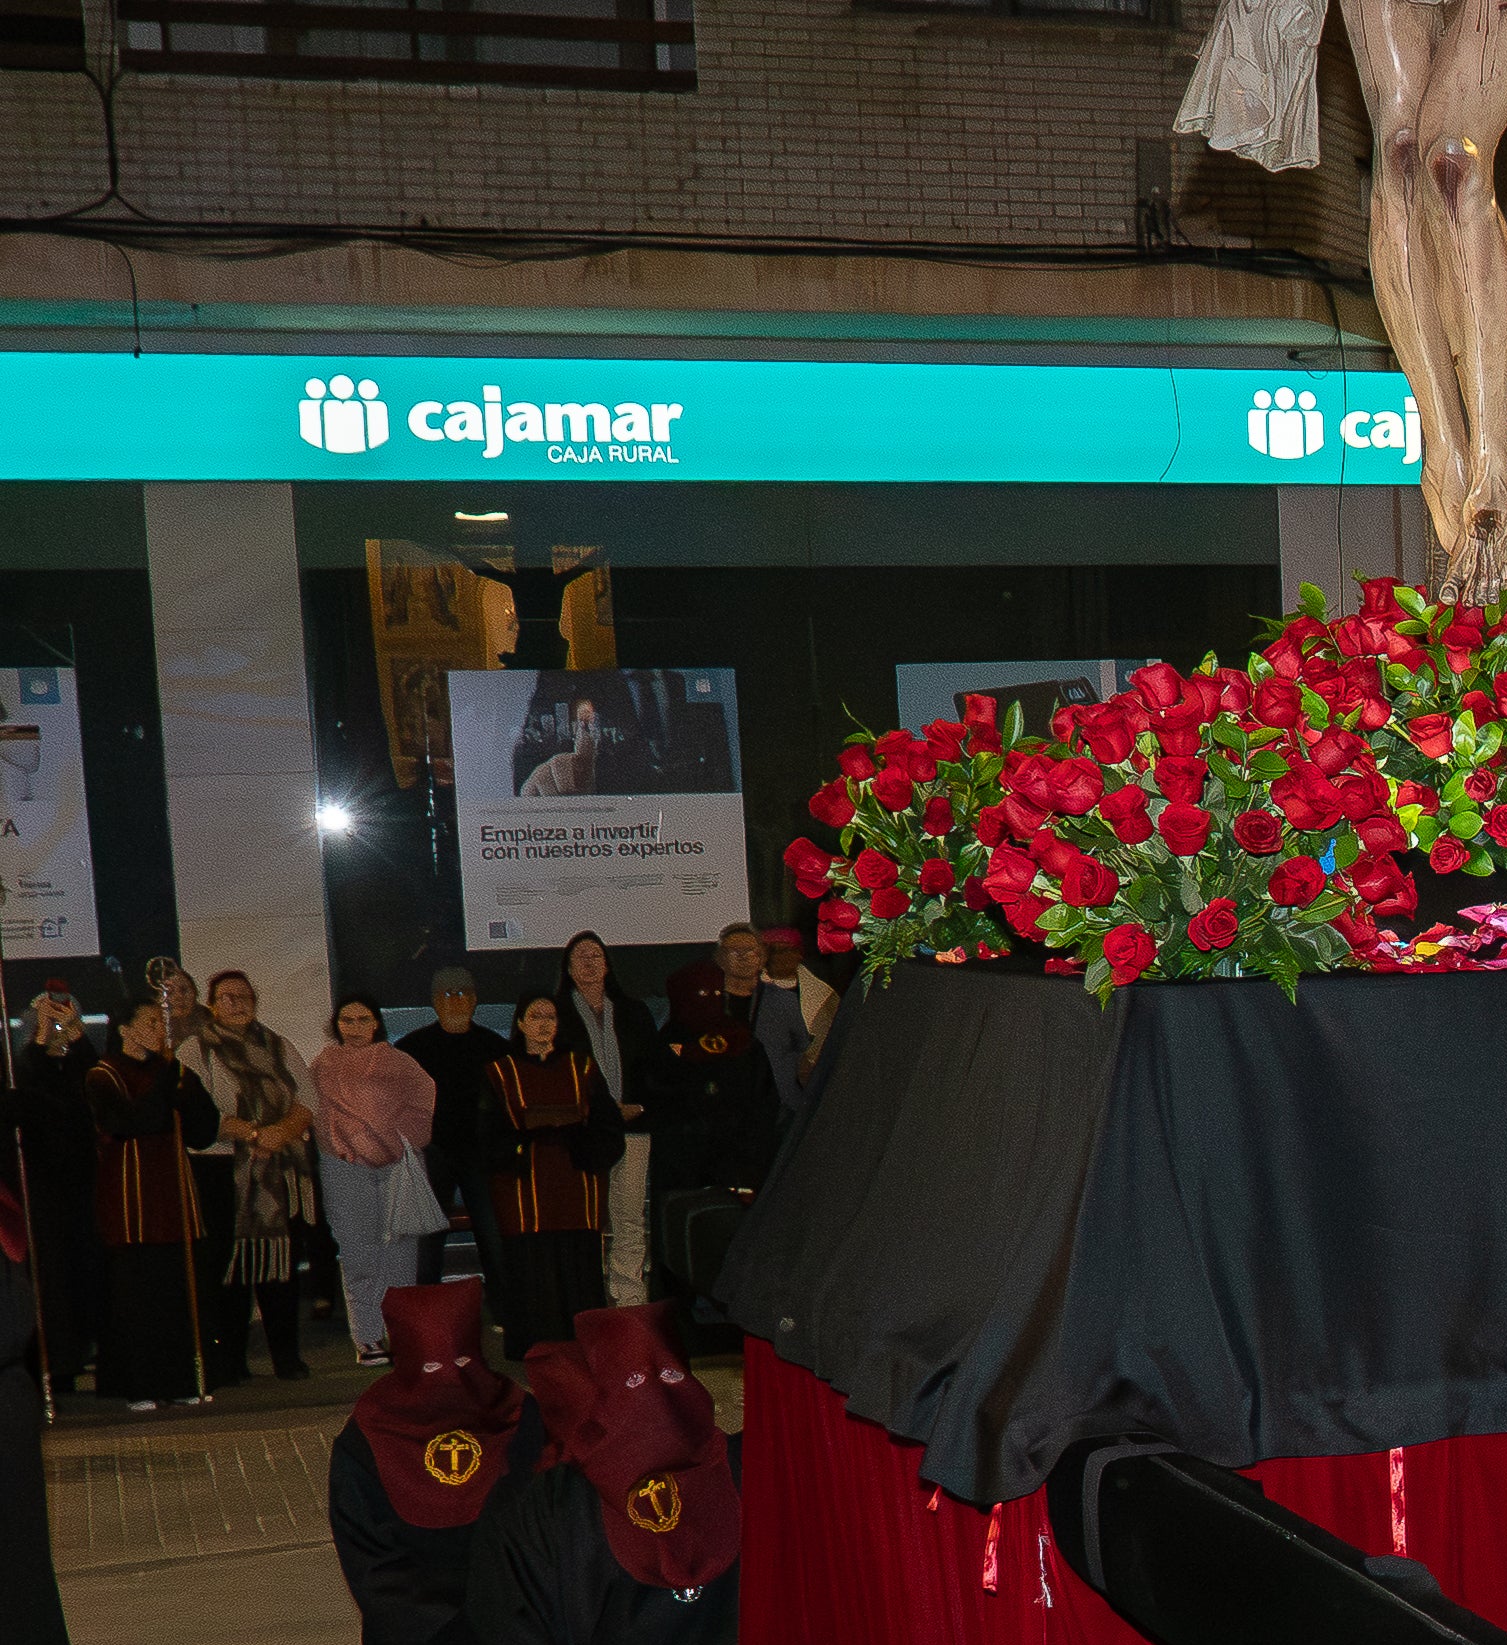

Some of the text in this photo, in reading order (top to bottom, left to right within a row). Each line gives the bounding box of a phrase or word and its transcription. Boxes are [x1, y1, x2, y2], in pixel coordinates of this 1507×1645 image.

[407, 384, 684, 459] cajamar
[547, 445, 680, 464] CAJA RURAL
[480, 821, 661, 843] Empieza a invertir
[481, 840, 705, 860] con nuestros expertos
